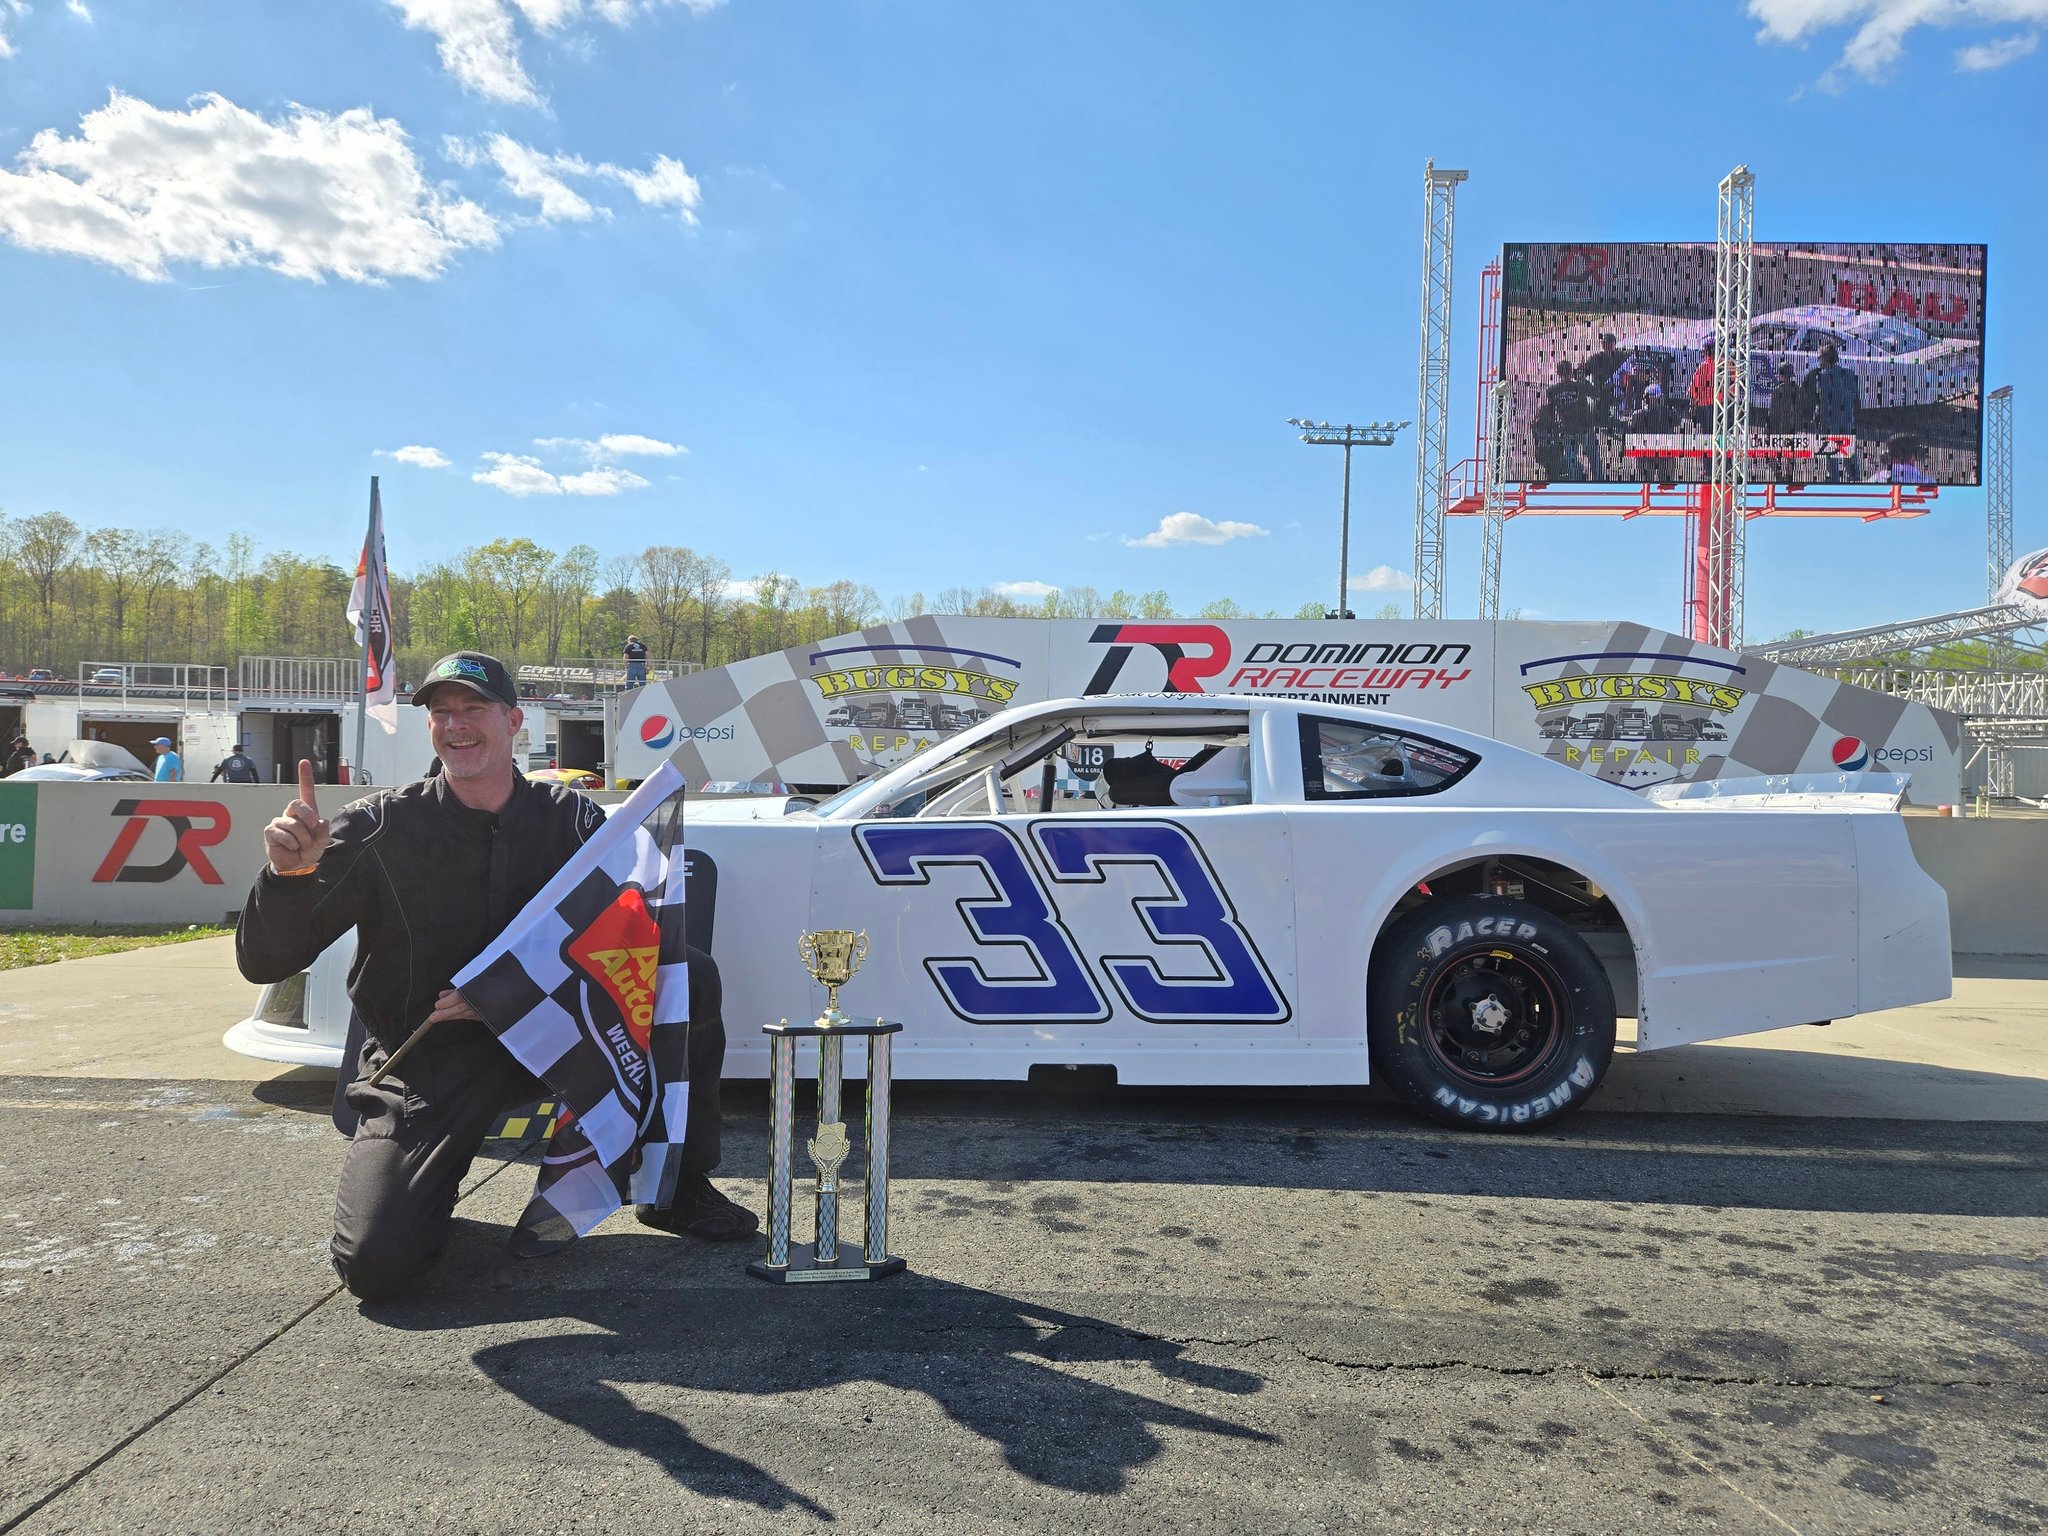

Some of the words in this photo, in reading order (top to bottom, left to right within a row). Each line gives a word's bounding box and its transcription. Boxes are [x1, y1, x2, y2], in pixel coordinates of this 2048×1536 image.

[1243, 643, 1472, 664] DOMINION
[518, 665, 594, 676] CAPITOL
[1227, 668, 1472, 689] RACEWAY
[816, 667, 1016, 702] BUGSY'S
[1527, 676, 1742, 712] BUGSY'S
[1244, 692, 1391, 705] ERTAINMENT
[678, 723, 735, 742] pepsi
[849, 735, 929, 752] REPA
[1565, 746, 1702, 764] REPAIR
[1873, 745, 1934, 767] pepsi
[851, 818, 1293, 1025] 33
[1426, 917, 1538, 958] RACER
[606, 1022, 647, 1091] WEEKL
[1435, 1056, 1594, 1124] AMERICAN
